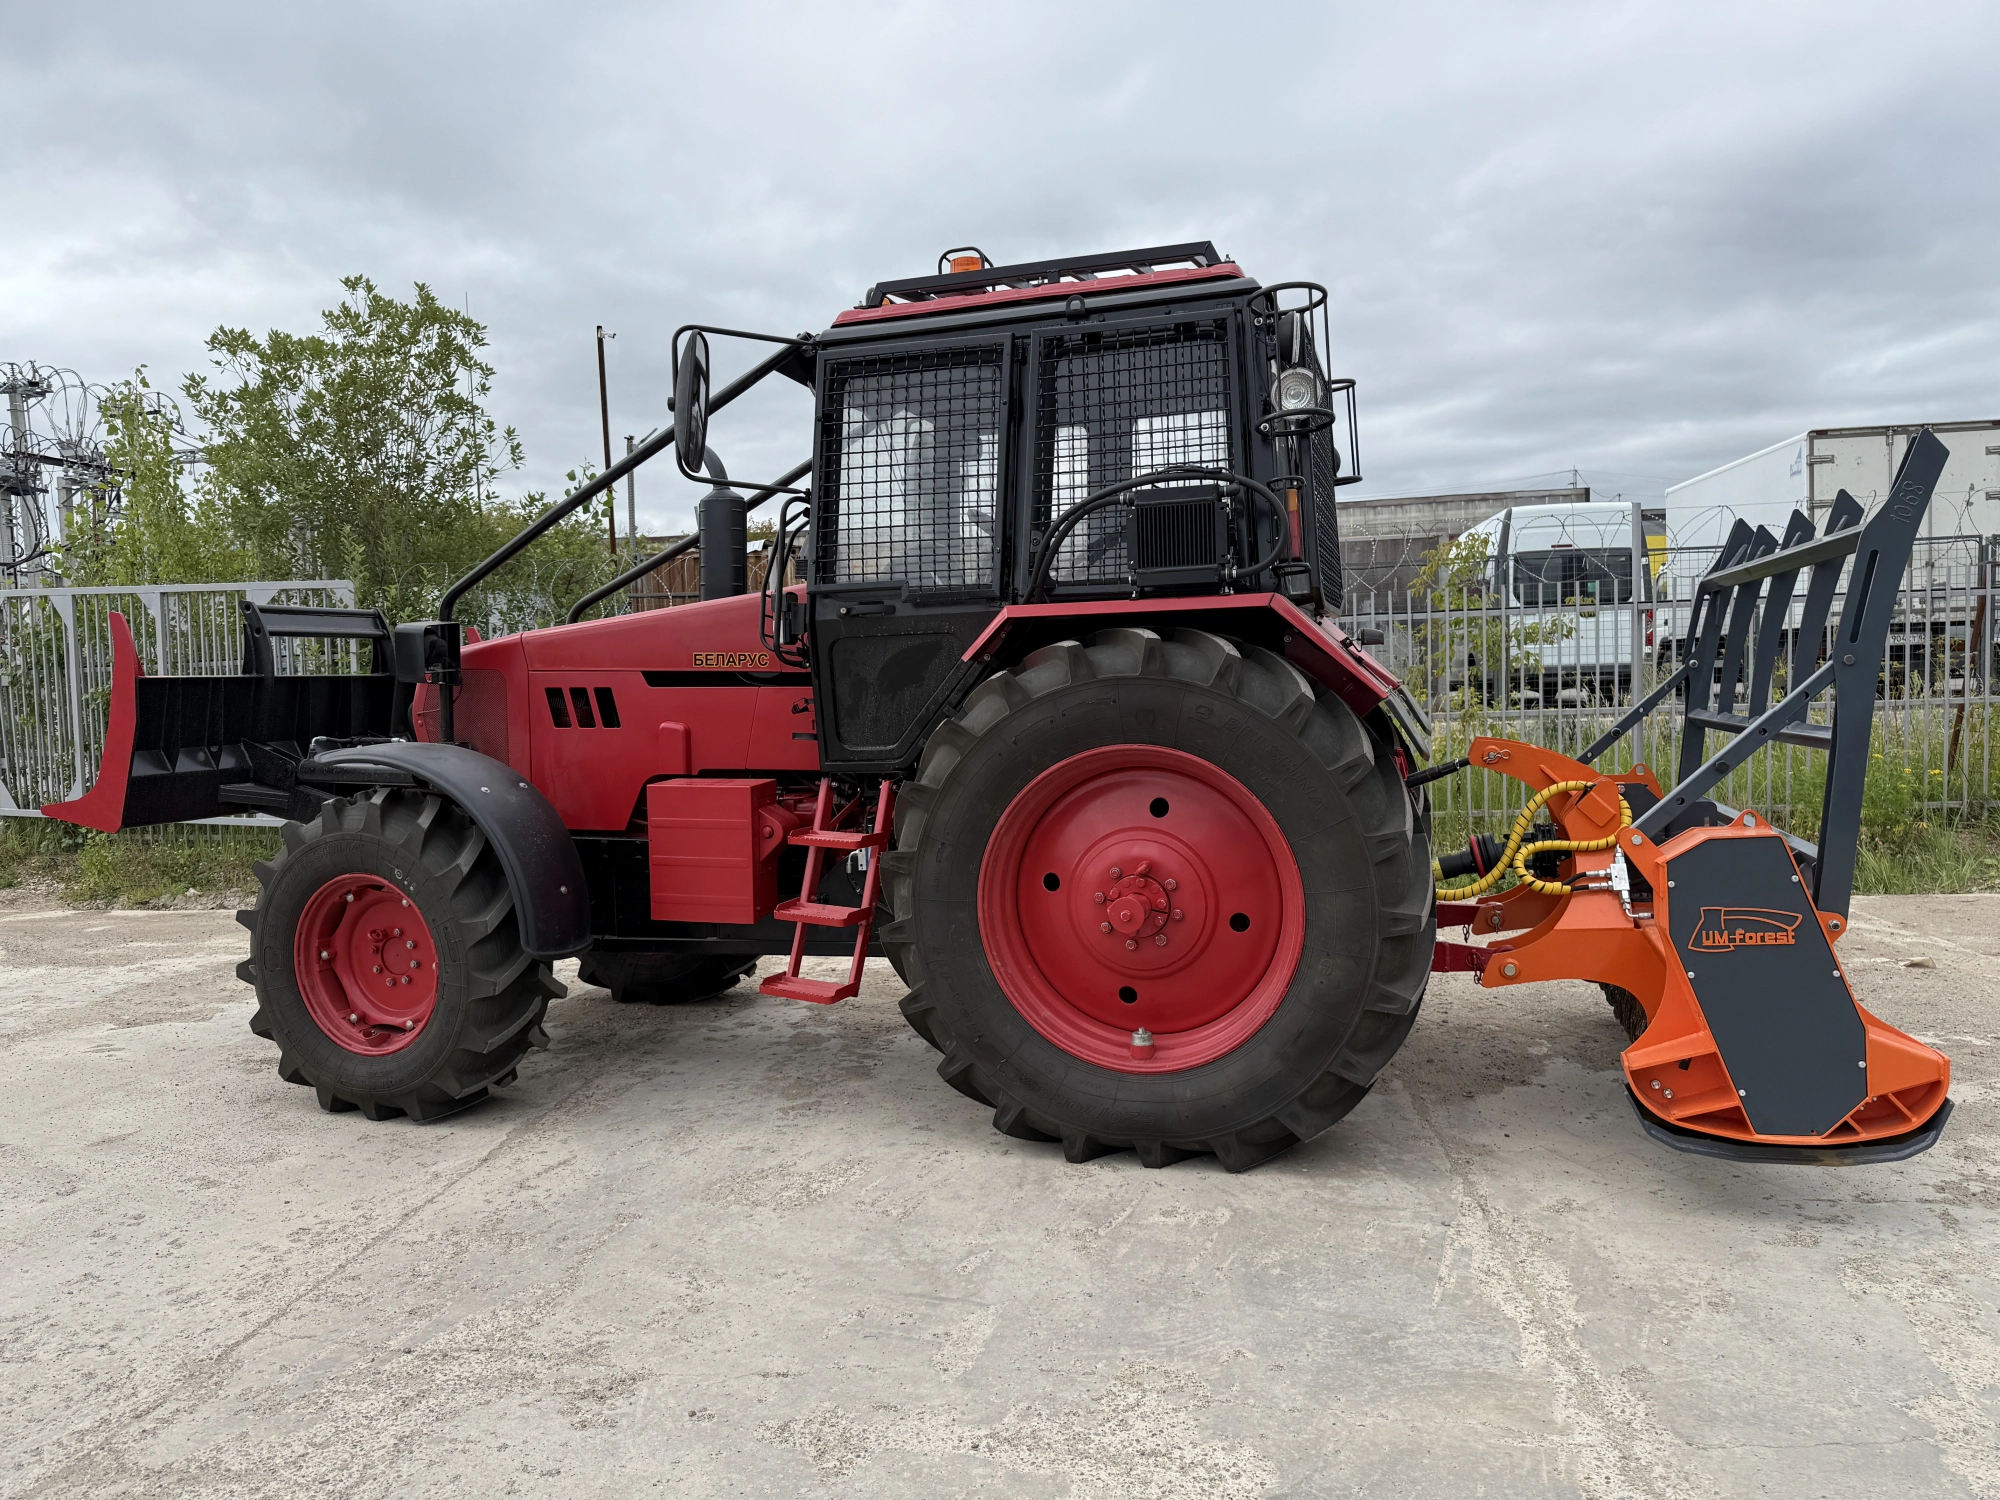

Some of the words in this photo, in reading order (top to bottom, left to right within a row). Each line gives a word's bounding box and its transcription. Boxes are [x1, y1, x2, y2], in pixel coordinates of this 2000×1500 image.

[1890, 481, 1924, 523] 1068
[693, 652, 769, 668] БЕЛАРУС
[1223, 717, 1325, 811] BELSHINA
[289, 842, 362, 881] BELSHINA
[1024, 1076, 1157, 1125] 520/70R38
